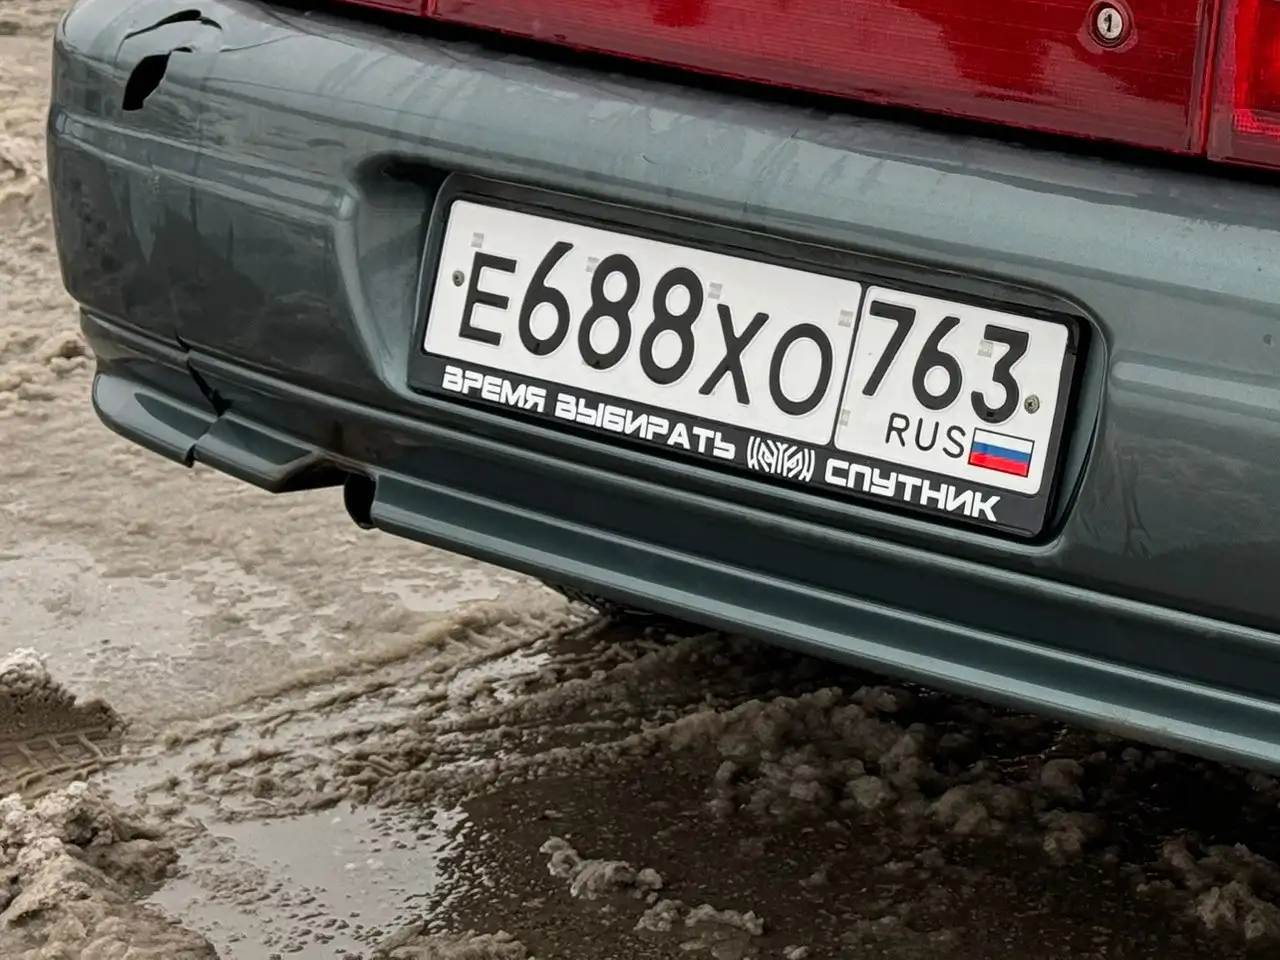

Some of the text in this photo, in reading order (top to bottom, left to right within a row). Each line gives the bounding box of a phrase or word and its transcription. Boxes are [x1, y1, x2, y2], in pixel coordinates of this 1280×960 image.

[861, 299, 1030, 424] 763
[441, 364, 1001, 522] ВРЕМЯ ВЫБИРАТЬ СПУТНИК
[884, 411, 967, 459] RUS
